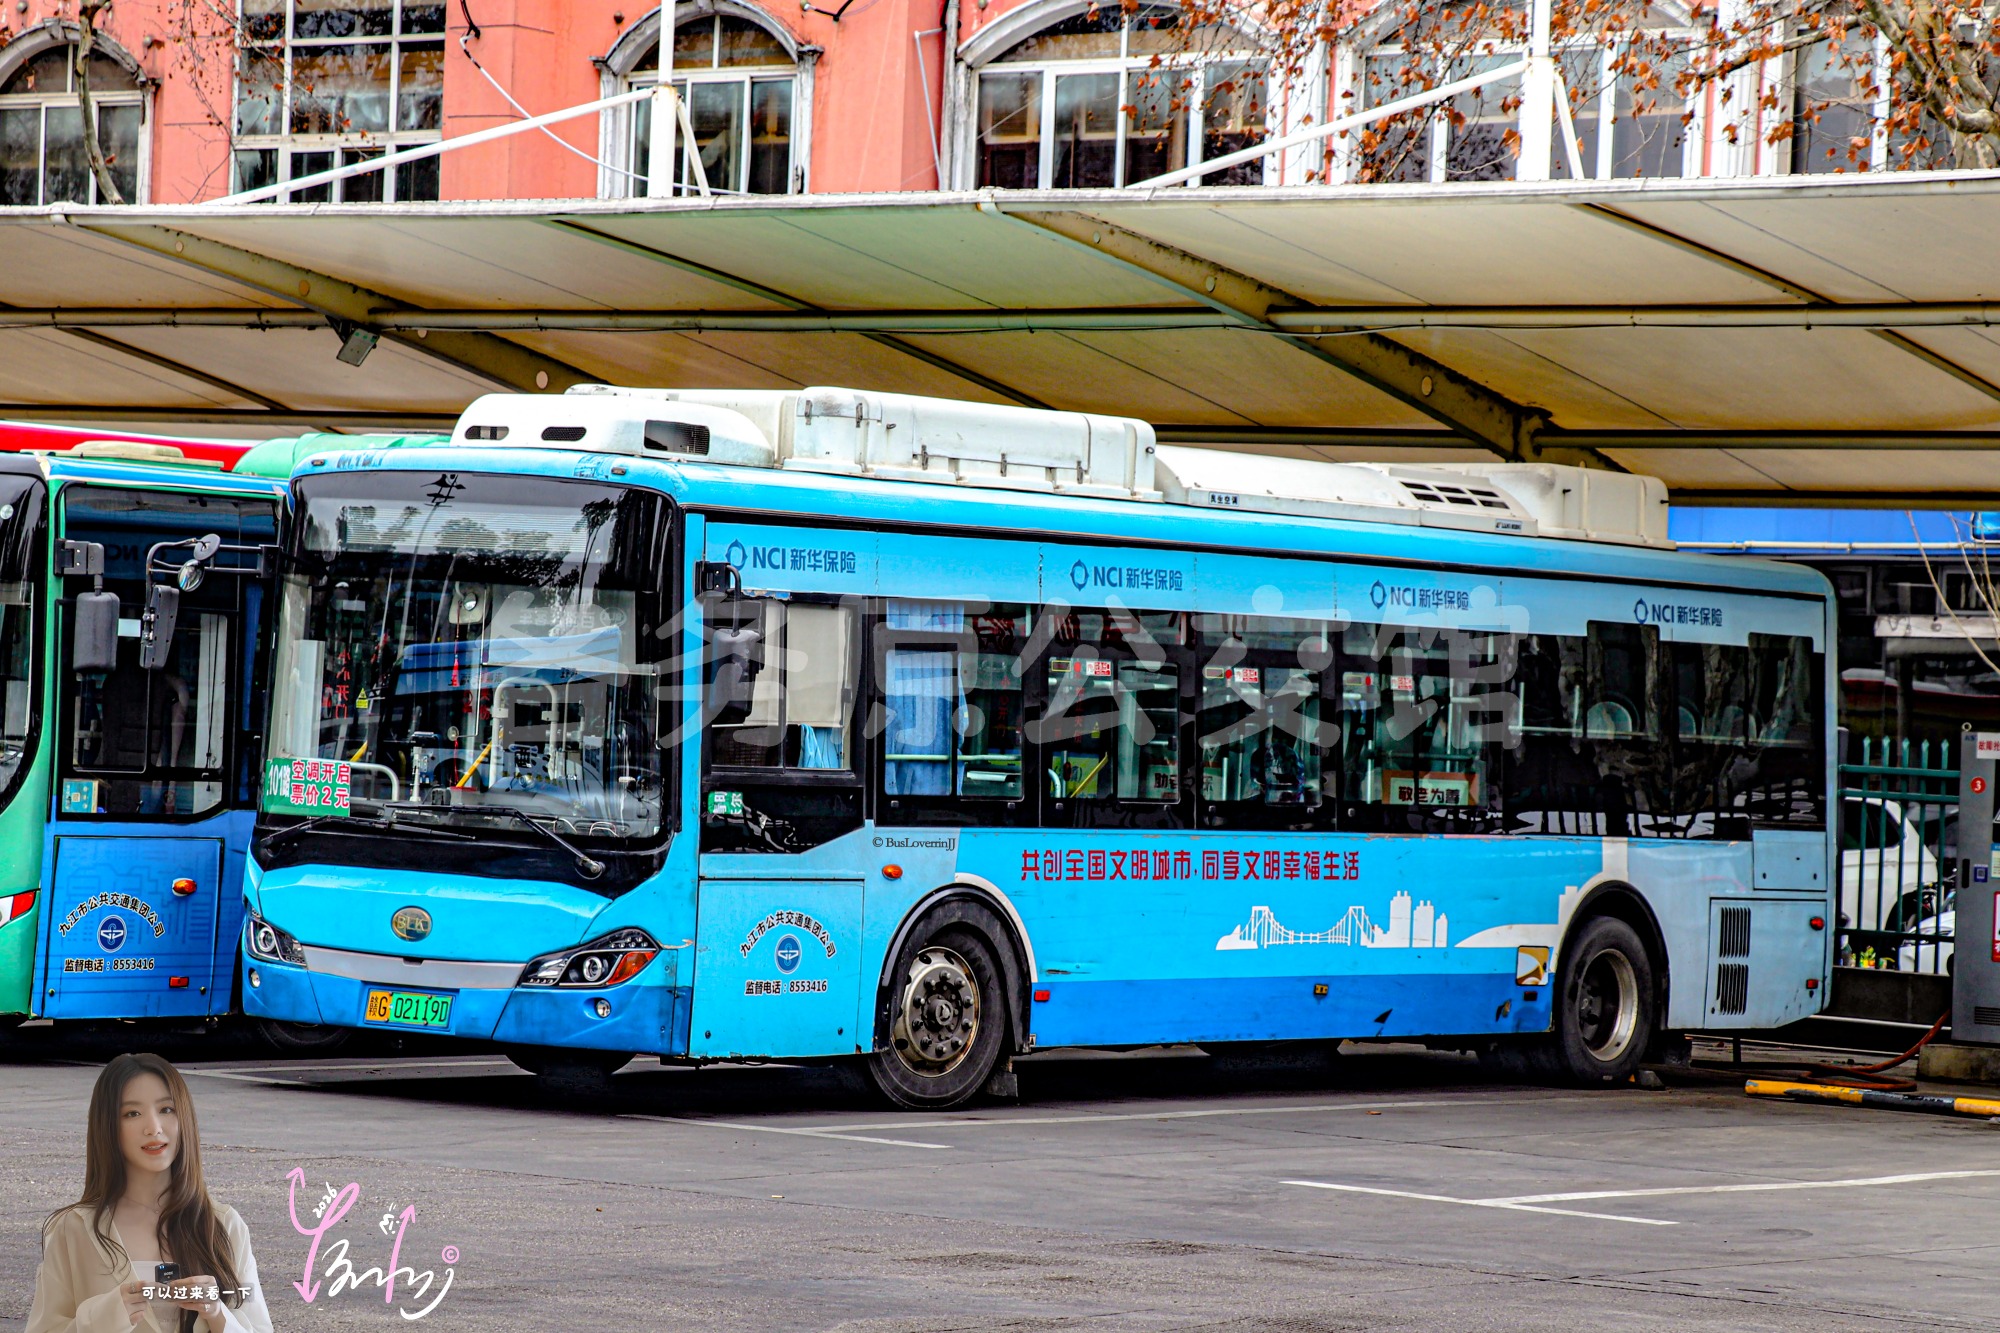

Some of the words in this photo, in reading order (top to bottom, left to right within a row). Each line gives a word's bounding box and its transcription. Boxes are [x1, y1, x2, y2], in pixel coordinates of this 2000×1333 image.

[753, 547, 786, 570] NCI
[790, 548, 856, 574] 新华保险
[1093, 566, 1123, 588] NCI
[1126, 567, 1183, 591] 新华保险
[1390, 586, 1416, 607] NCI
[1419, 588, 1469, 611] 新华保险
[1652, 604, 1675, 623] NCI
[1677, 605, 1722, 627] 新华保险
[292, 760, 351, 785] 空调开启
[290, 783, 350, 808] 票价2元
[1974, 780, 1982, 791] 3
[58, 891, 166, 938] 九江市公共交通集团公司
[740, 910, 837, 958] 九江市公共交通集团公司
